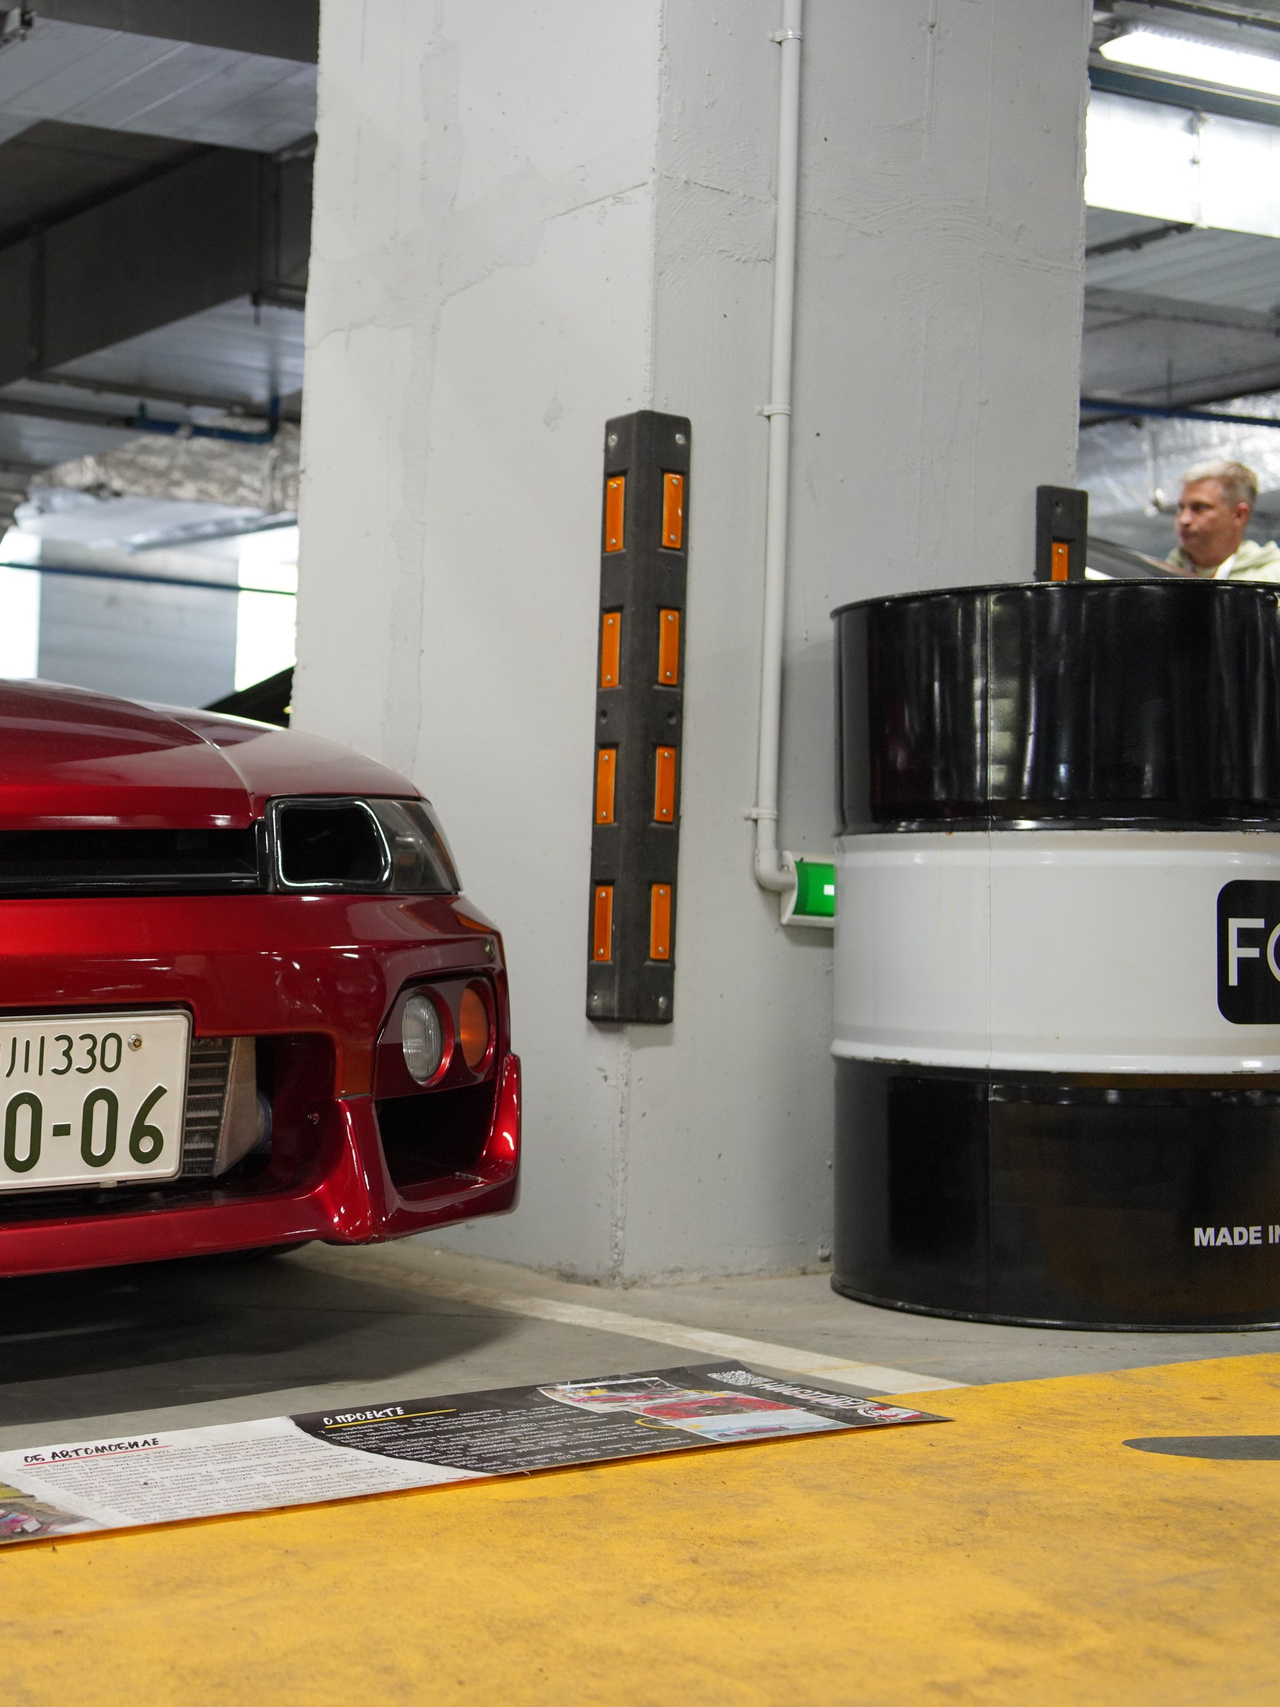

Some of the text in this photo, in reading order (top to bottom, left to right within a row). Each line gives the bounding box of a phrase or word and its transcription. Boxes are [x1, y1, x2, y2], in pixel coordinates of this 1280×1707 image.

[1228, 917, 1280, 986] F
[1193, 1226, 1262, 1247] MADE
[323, 1417, 333, 1426] О
[336, 1406, 405, 1424] ПРОЕКТЕ
[24, 1453, 45, 1464] ОБ
[51, 1438, 160, 1461] АВТОМОБИЛЕ
